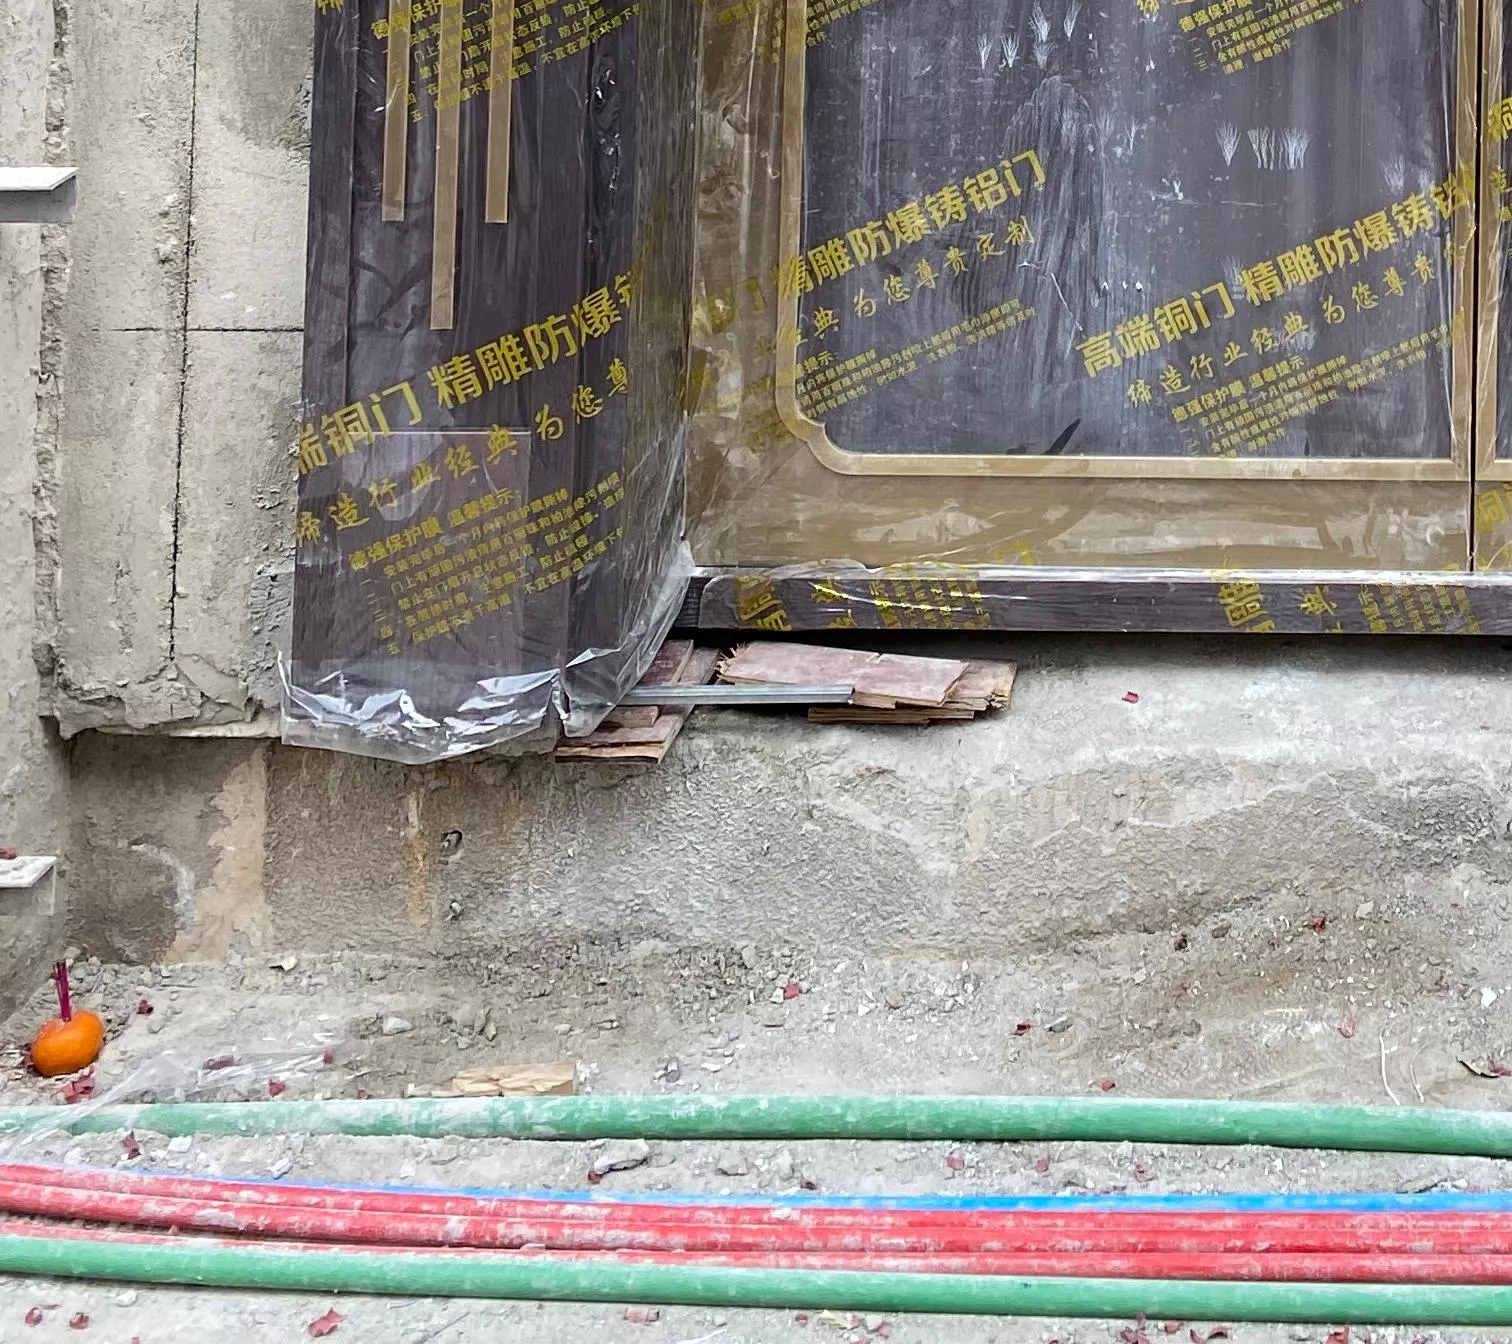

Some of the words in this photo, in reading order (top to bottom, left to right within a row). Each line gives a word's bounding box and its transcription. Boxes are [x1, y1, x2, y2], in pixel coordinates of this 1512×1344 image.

[1074, 280, 1237, 378] 高端铜门
[1126, 311, 1311, 408] 缔造行业经典
